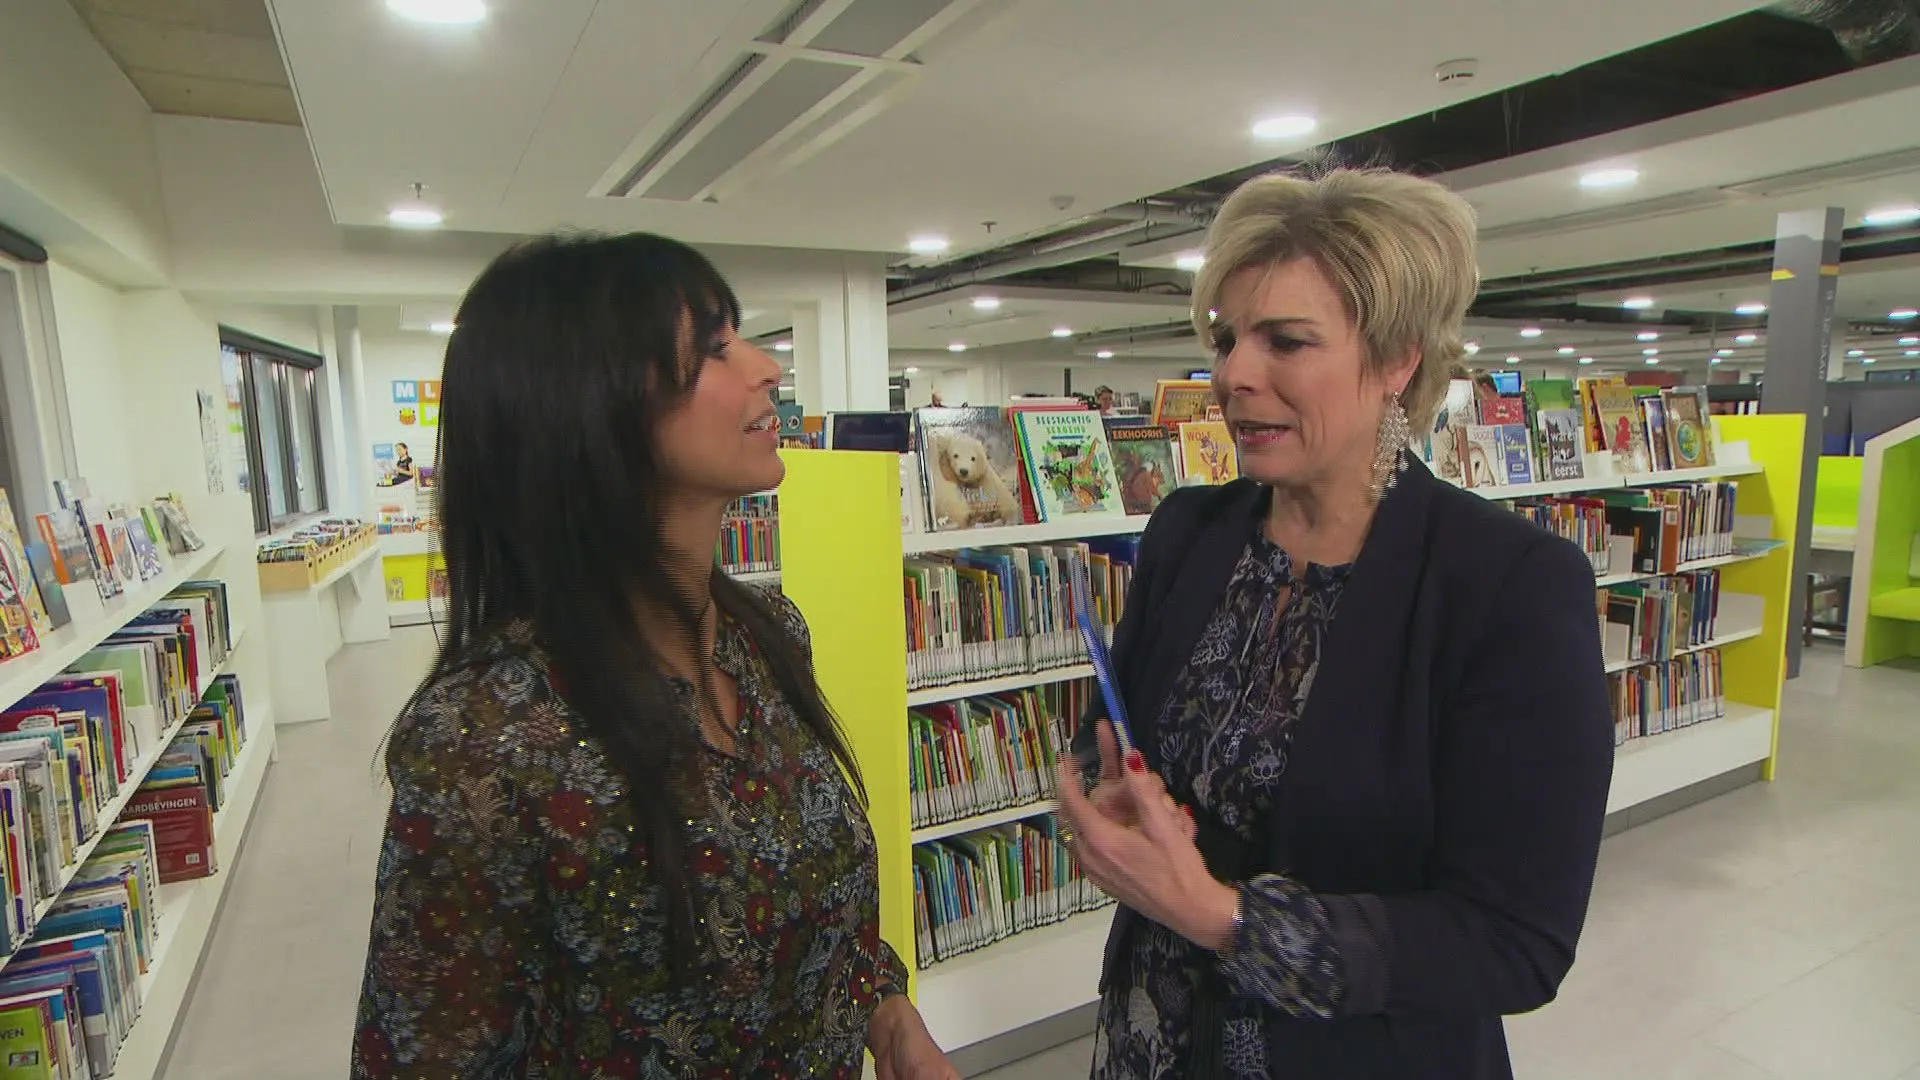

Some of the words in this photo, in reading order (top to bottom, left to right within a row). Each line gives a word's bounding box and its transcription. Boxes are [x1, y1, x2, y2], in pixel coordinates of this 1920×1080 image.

[1113, 428, 1164, 440] EEKHOORNS
[1555, 466, 1579, 477] eerst
[121, 798, 196, 814] AARDBEVINGEN
